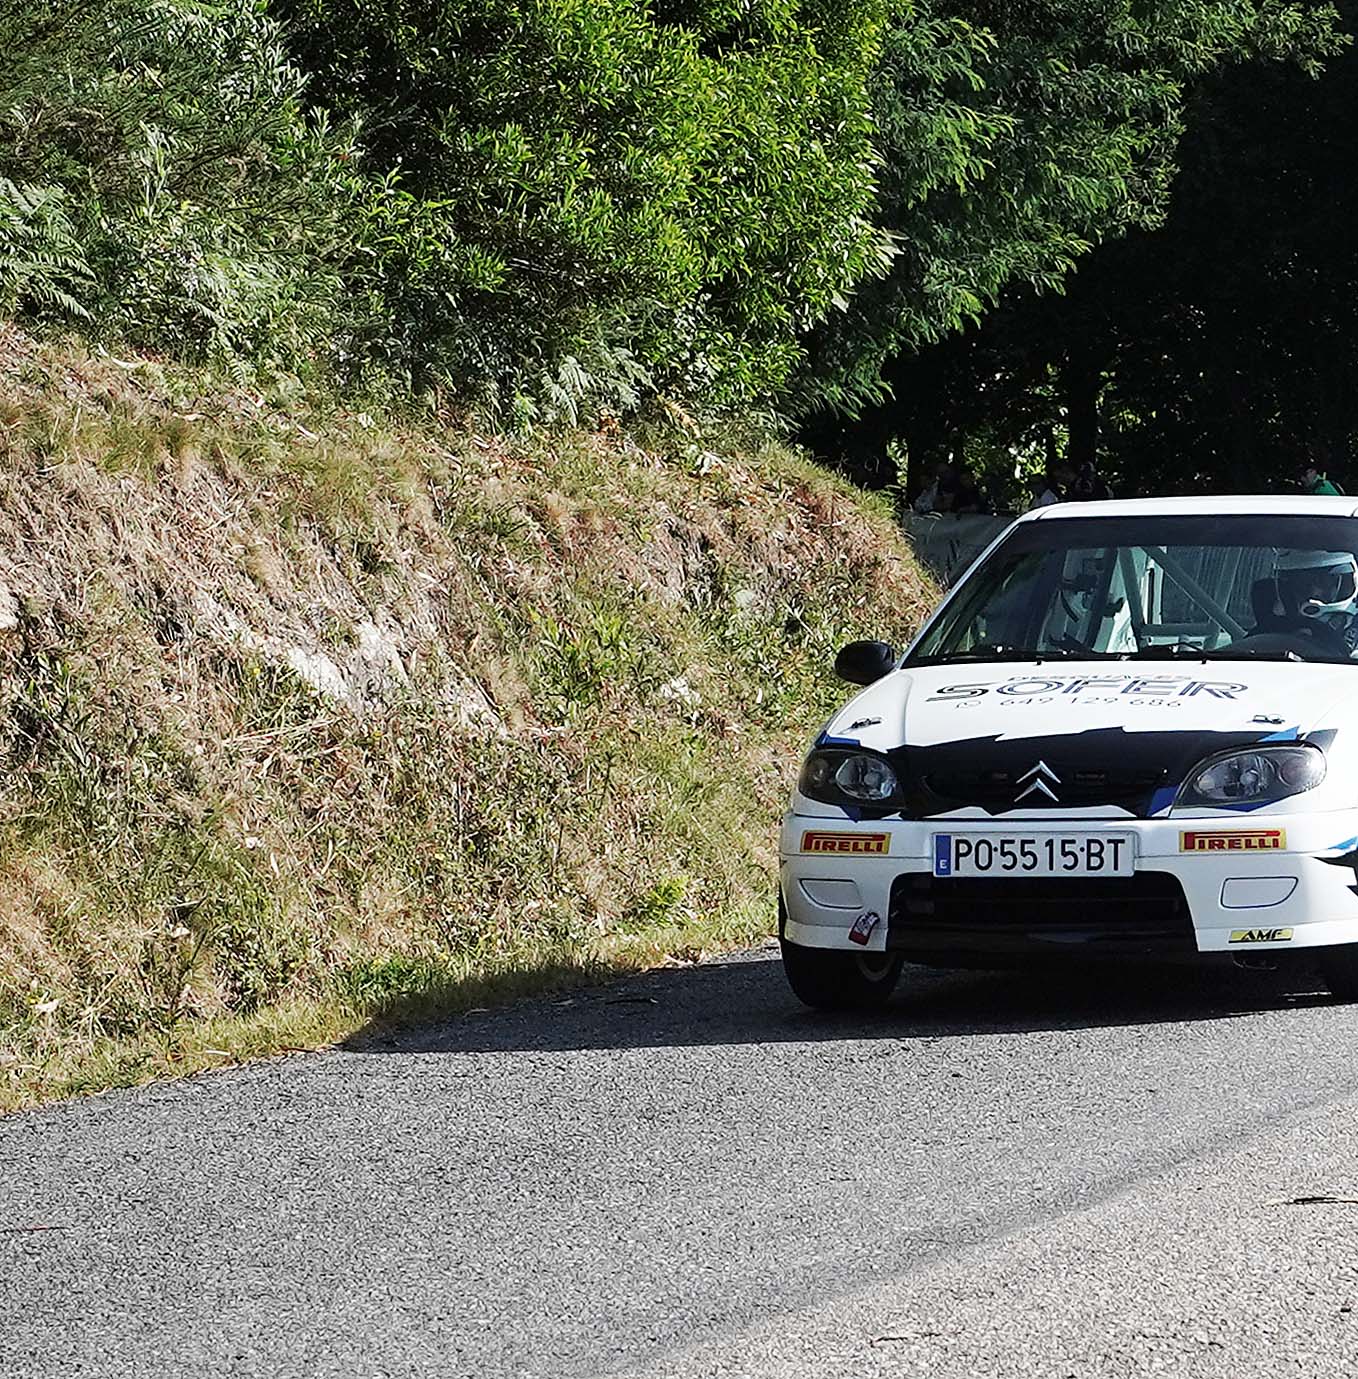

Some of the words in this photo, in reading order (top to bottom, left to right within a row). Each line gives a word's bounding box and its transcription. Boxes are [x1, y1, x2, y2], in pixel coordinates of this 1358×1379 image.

[925, 679, 1249, 702] SOFER
[999, 697, 1054, 706] 649
[1070, 697, 1119, 705] 129
[1129, 697, 1182, 707] 686
[803, 831, 887, 853] PIRELLI
[1184, 830, 1281, 850] PIRELLI
[939, 859, 948, 869] E
